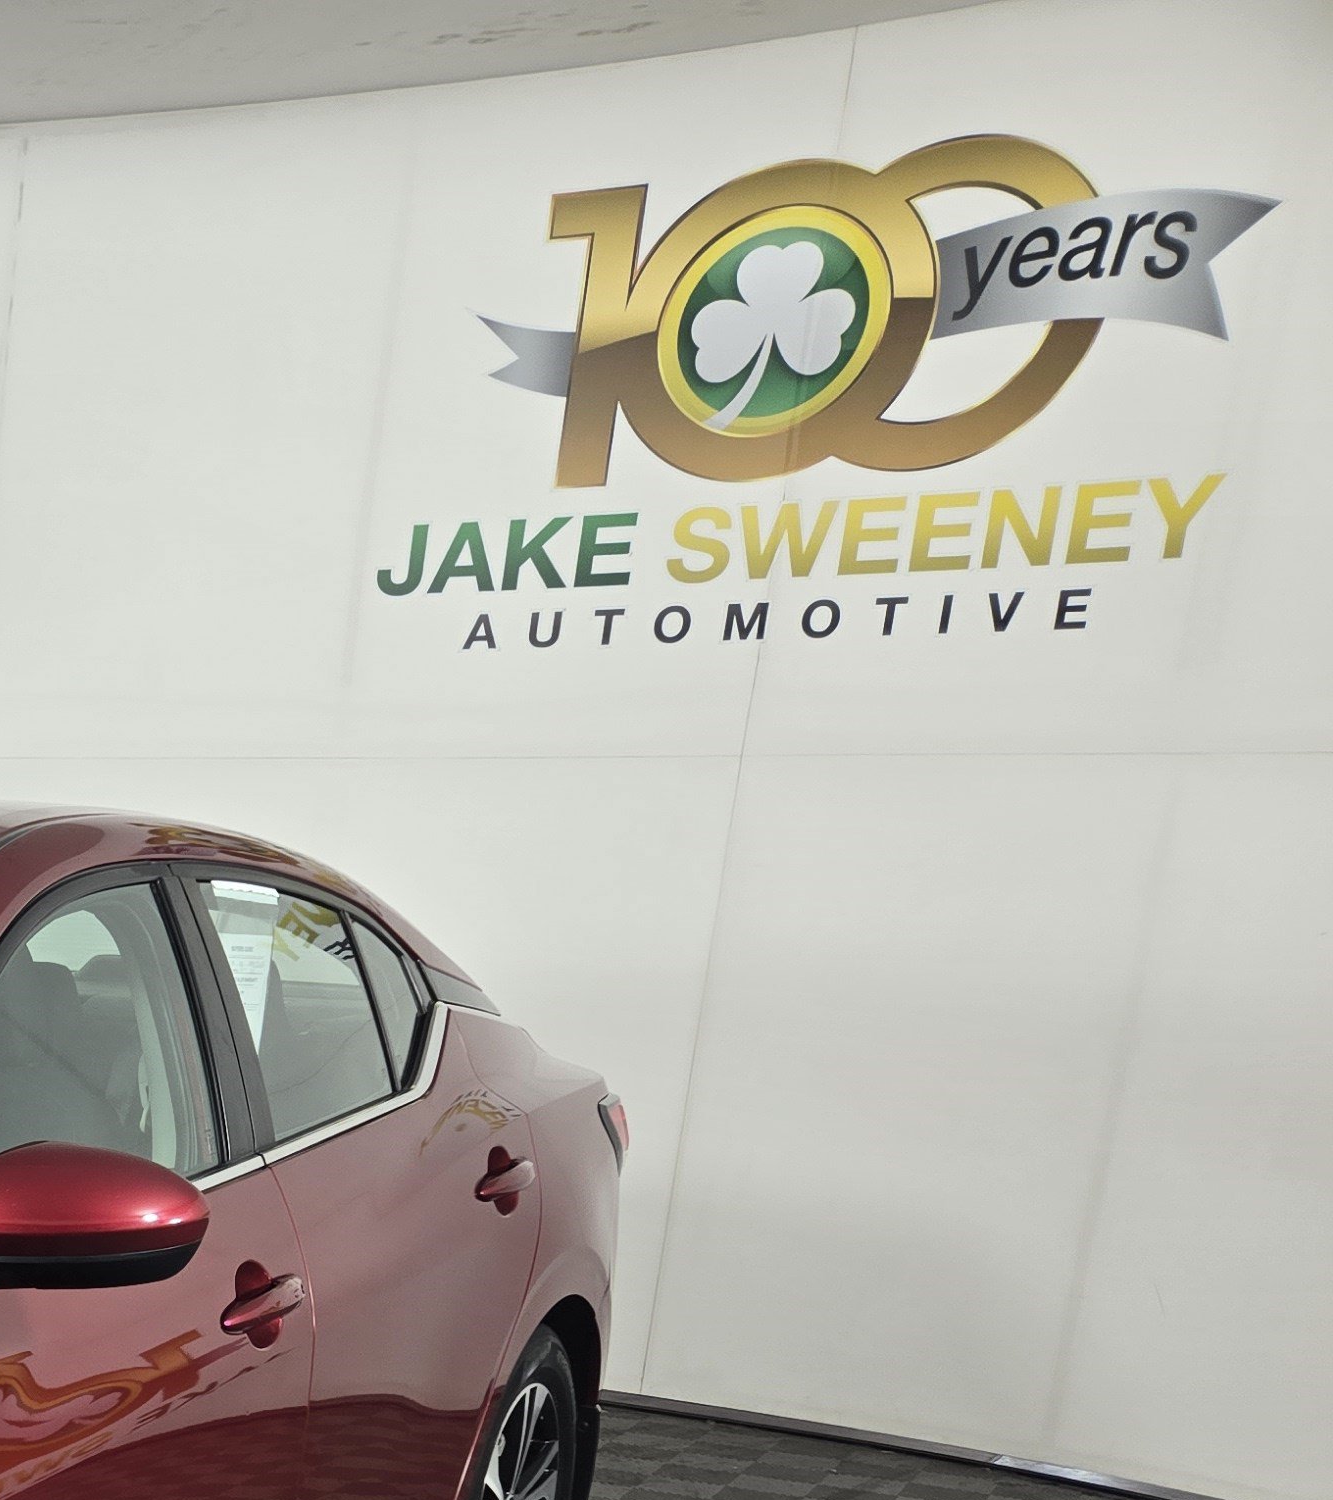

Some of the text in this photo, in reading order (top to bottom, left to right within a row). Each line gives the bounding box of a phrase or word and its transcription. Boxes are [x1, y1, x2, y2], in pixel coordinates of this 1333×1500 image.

[548, 133, 1197, 489] 100 years
[377, 472, 1226, 596] JAKE SWEENEY
[462, 588, 1092, 651] AUTOMOTIVE
